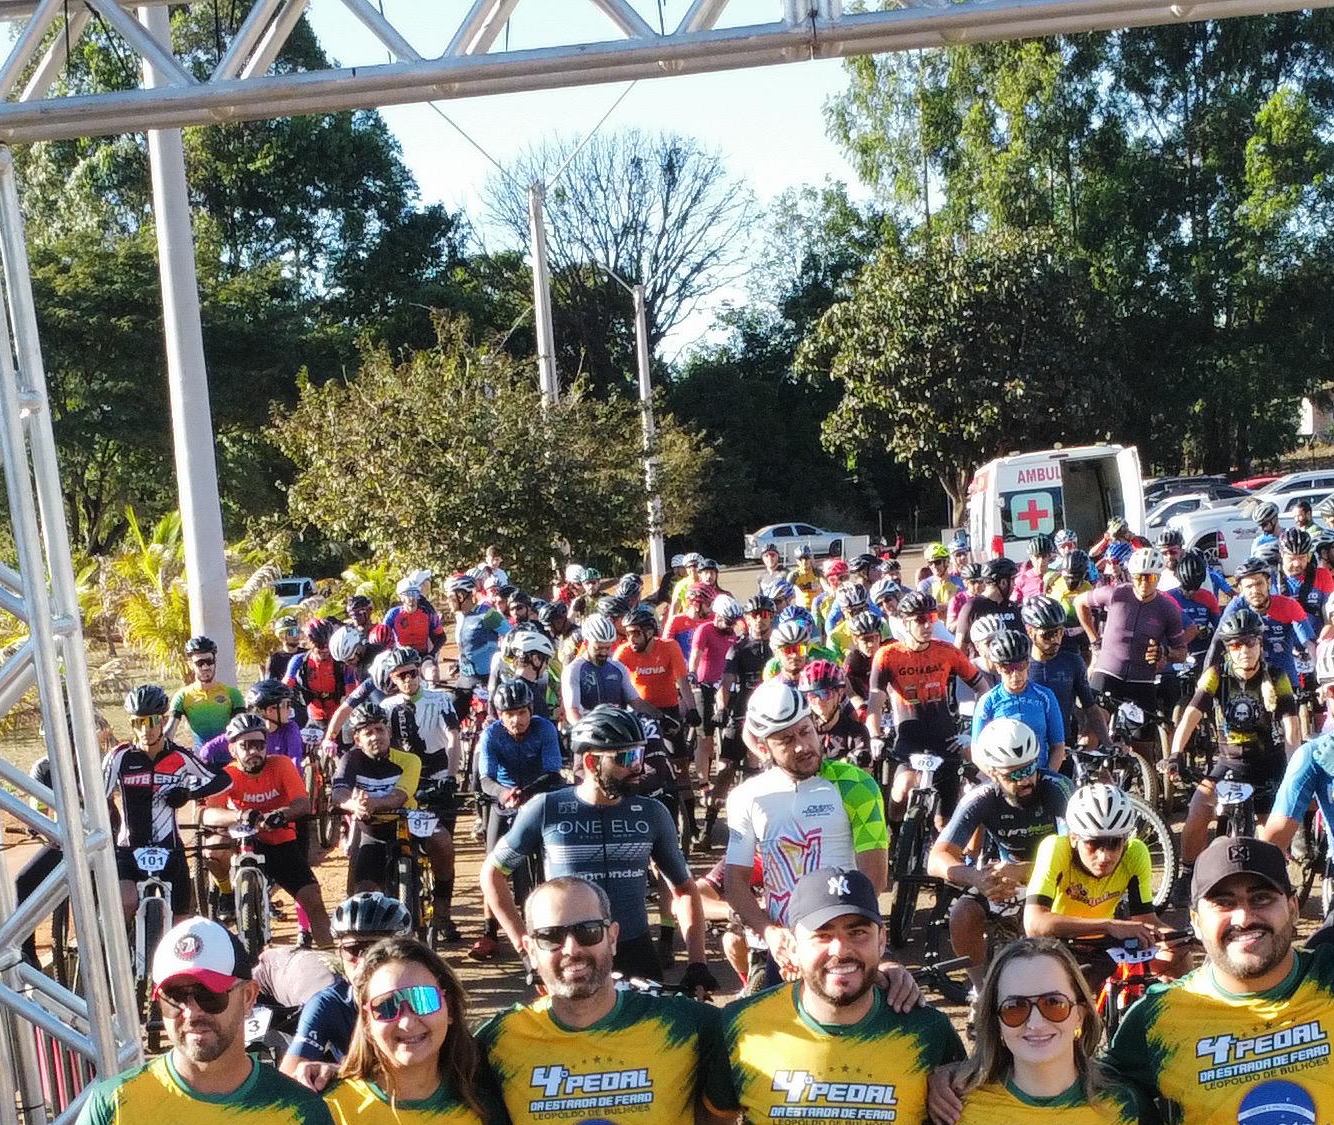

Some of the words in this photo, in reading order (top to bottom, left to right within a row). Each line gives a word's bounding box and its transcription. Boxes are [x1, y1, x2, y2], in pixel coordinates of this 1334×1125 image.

[414, 820, 429, 830] 91
[557, 820, 602, 834] ONE
[611, 820, 649, 834] ELO
[140, 856, 164, 865] 101
[1236, 1022, 1327, 1059] PEDAL
[1217, 1059, 1271, 1079] ESTRADA
[1274, 1055, 1289, 1065] DE
[1291, 1044, 1329, 1061] FERRO
[565, 1069, 652, 1094] PEDAL
[1204, 1073, 1260, 1090] LEOPOLDO
[547, 1098, 597, 1110] ESTRADA
[599, 1096, 612, 1106] DE
[615, 1092, 653, 1104] FERRO
[808, 1084, 898, 1104] PEDAL
[533, 1111, 585, 1120] LEOPOLDO
[786, 1107, 840, 1117] ESTRADA
[842, 1109, 856, 1118] DE
[858, 1110, 895, 1120] FERRO
